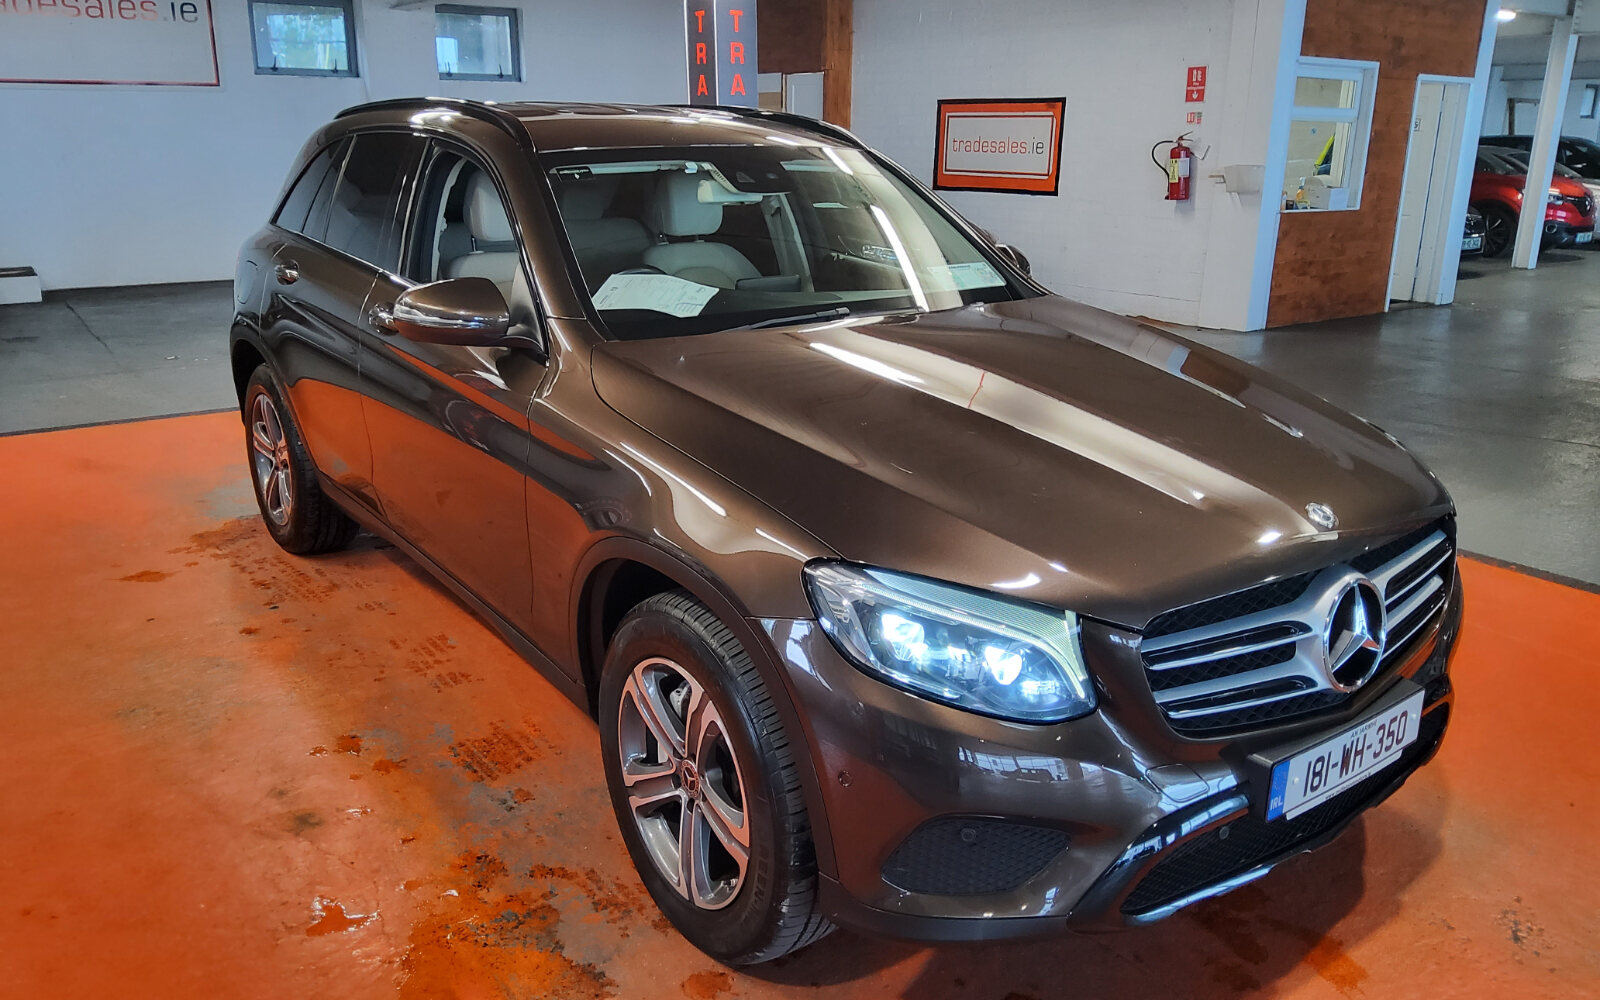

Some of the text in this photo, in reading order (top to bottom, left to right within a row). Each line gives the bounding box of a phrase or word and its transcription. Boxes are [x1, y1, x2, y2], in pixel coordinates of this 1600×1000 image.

[952, 136, 1045, 155] tradesales.ie
[1303, 710, 1408, 798] 181-WH-350
[1269, 795, 1284, 811] IRL
